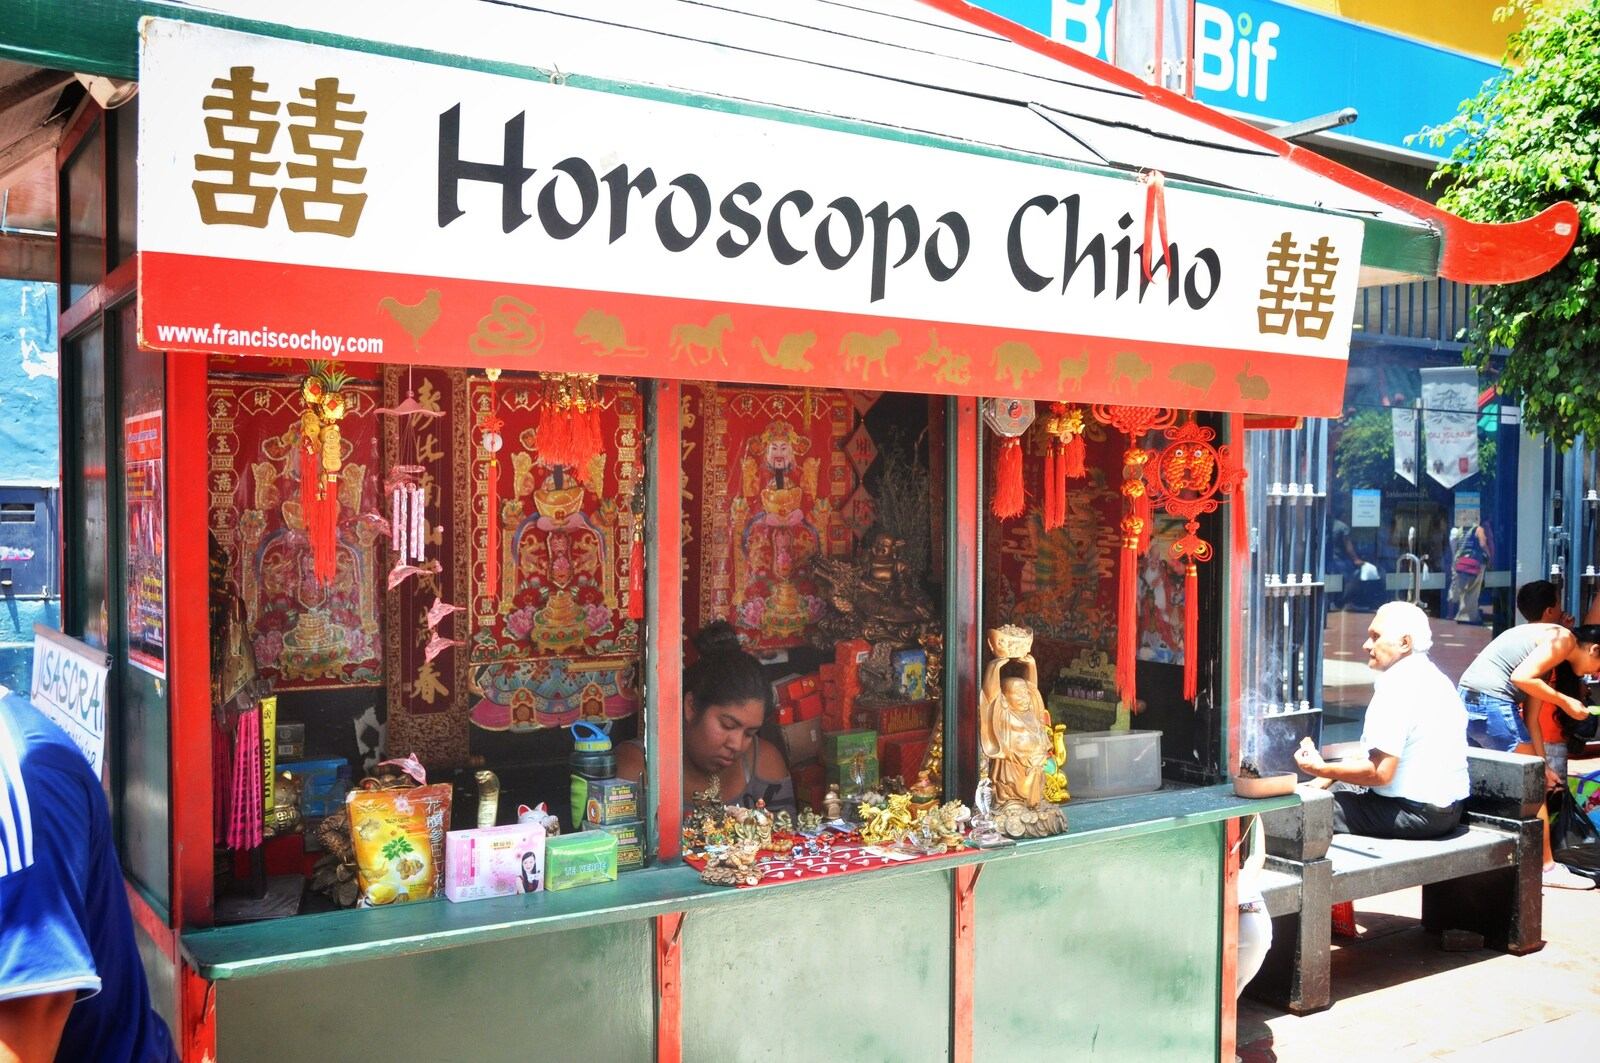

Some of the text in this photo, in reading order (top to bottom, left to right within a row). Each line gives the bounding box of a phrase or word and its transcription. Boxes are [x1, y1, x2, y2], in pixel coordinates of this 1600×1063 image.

[1195, 2, 1280, 102] Bif
[437, 103, 1222, 311] Horoscopo Chino
[157, 323, 384, 356] www.franciscochoy.com
